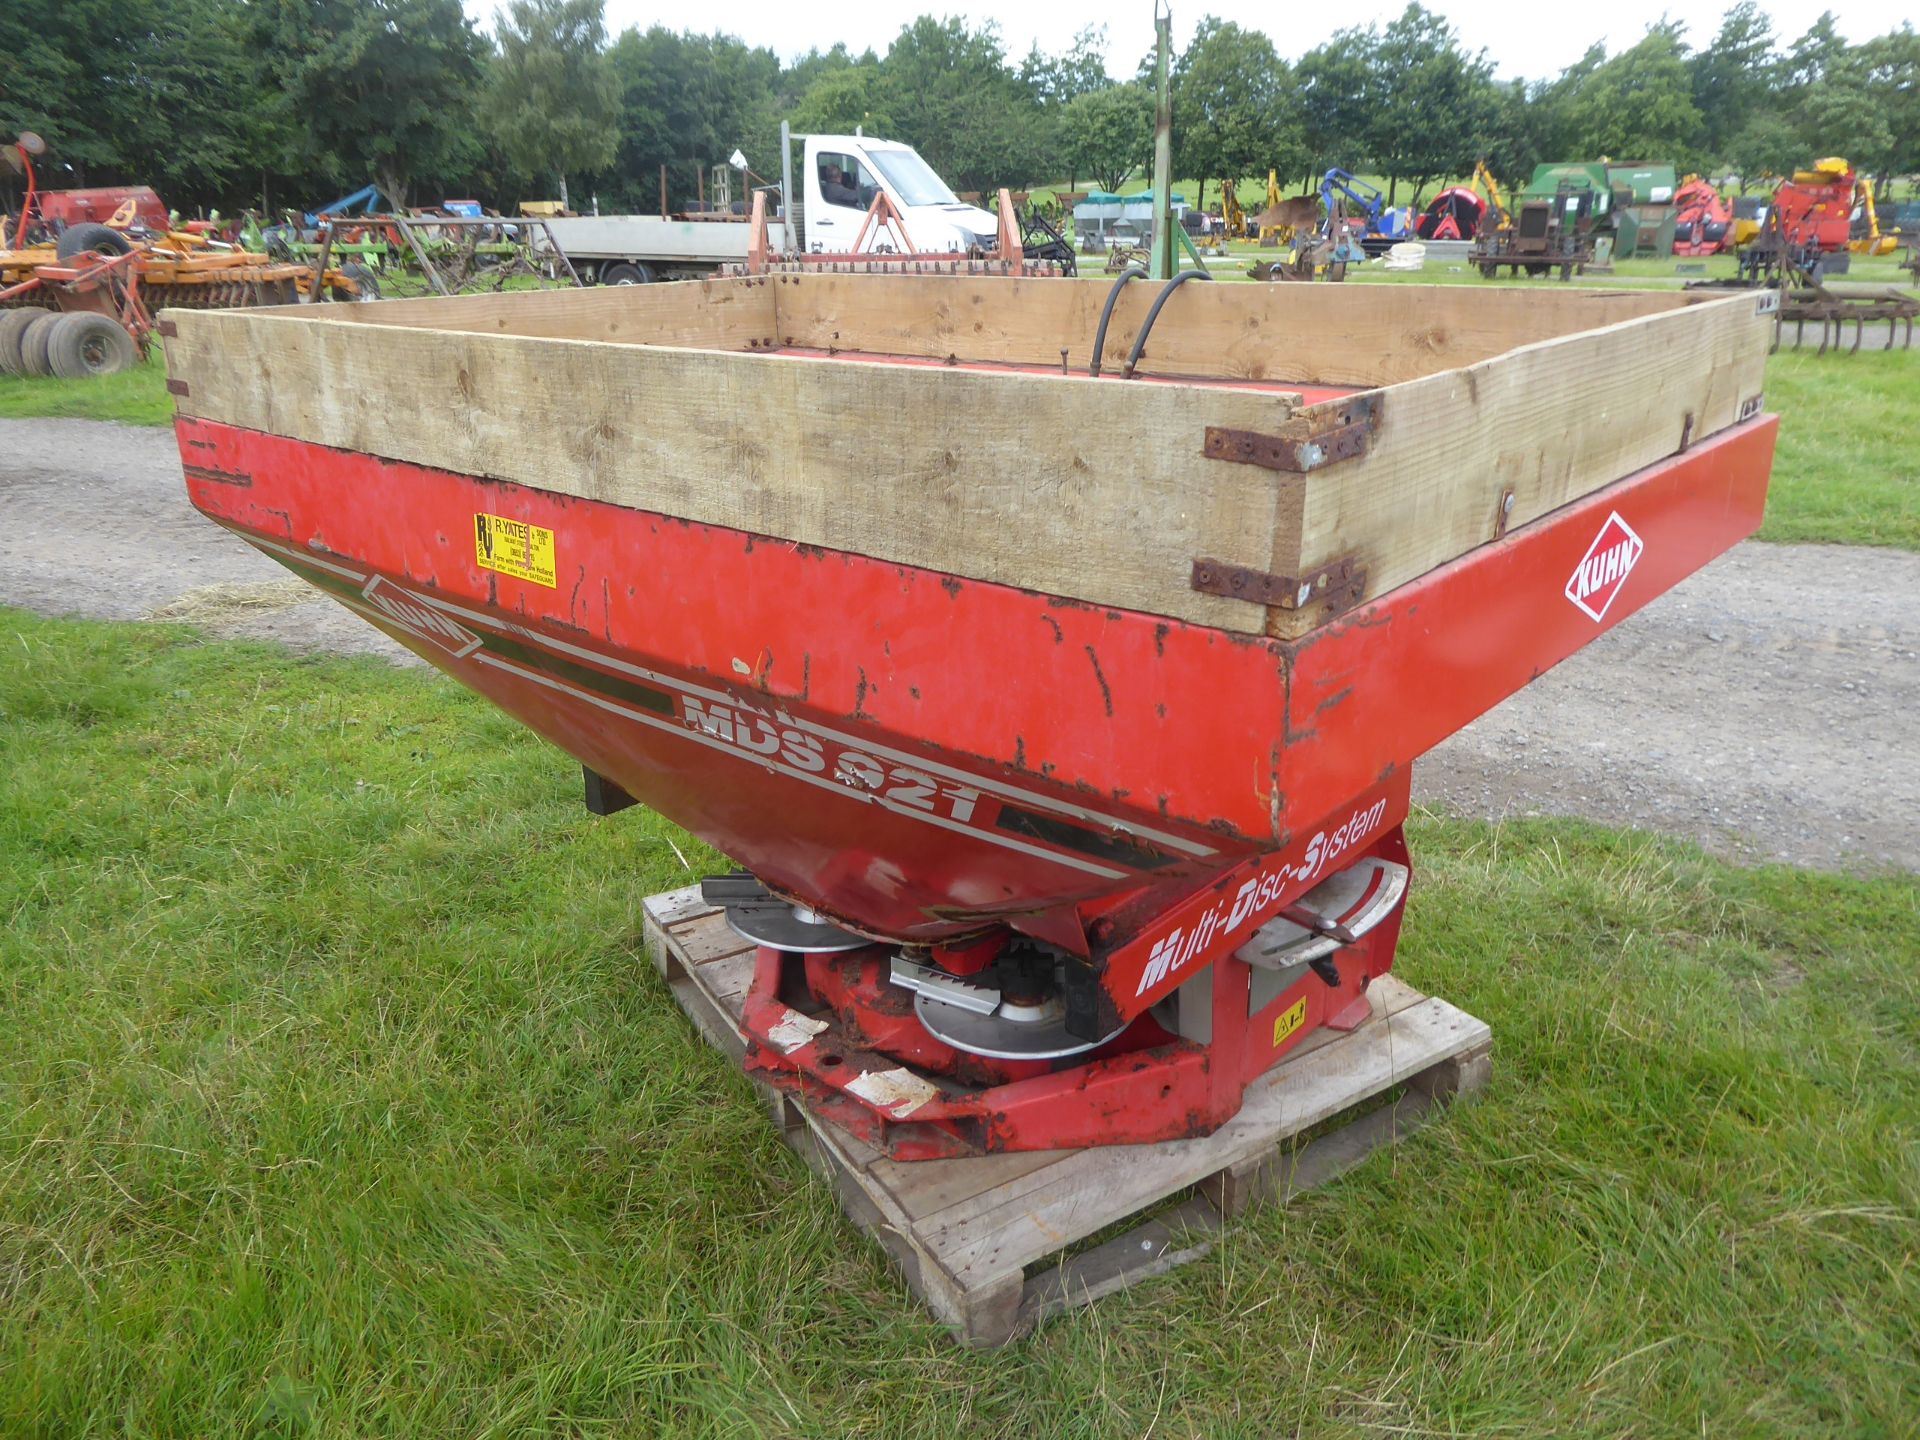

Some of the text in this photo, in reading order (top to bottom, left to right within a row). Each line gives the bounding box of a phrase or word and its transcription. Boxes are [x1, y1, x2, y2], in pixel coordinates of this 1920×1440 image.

[479, 558, 496, 567] SERVICE
[529, 573, 554, 584] SAFEGUARD
[536, 566, 553, 577] Holland
[1576, 536, 1635, 602] KUHN
[681, 694, 982, 823] MDS 921
[1135, 797, 1387, 997] Multi-Disc-System
